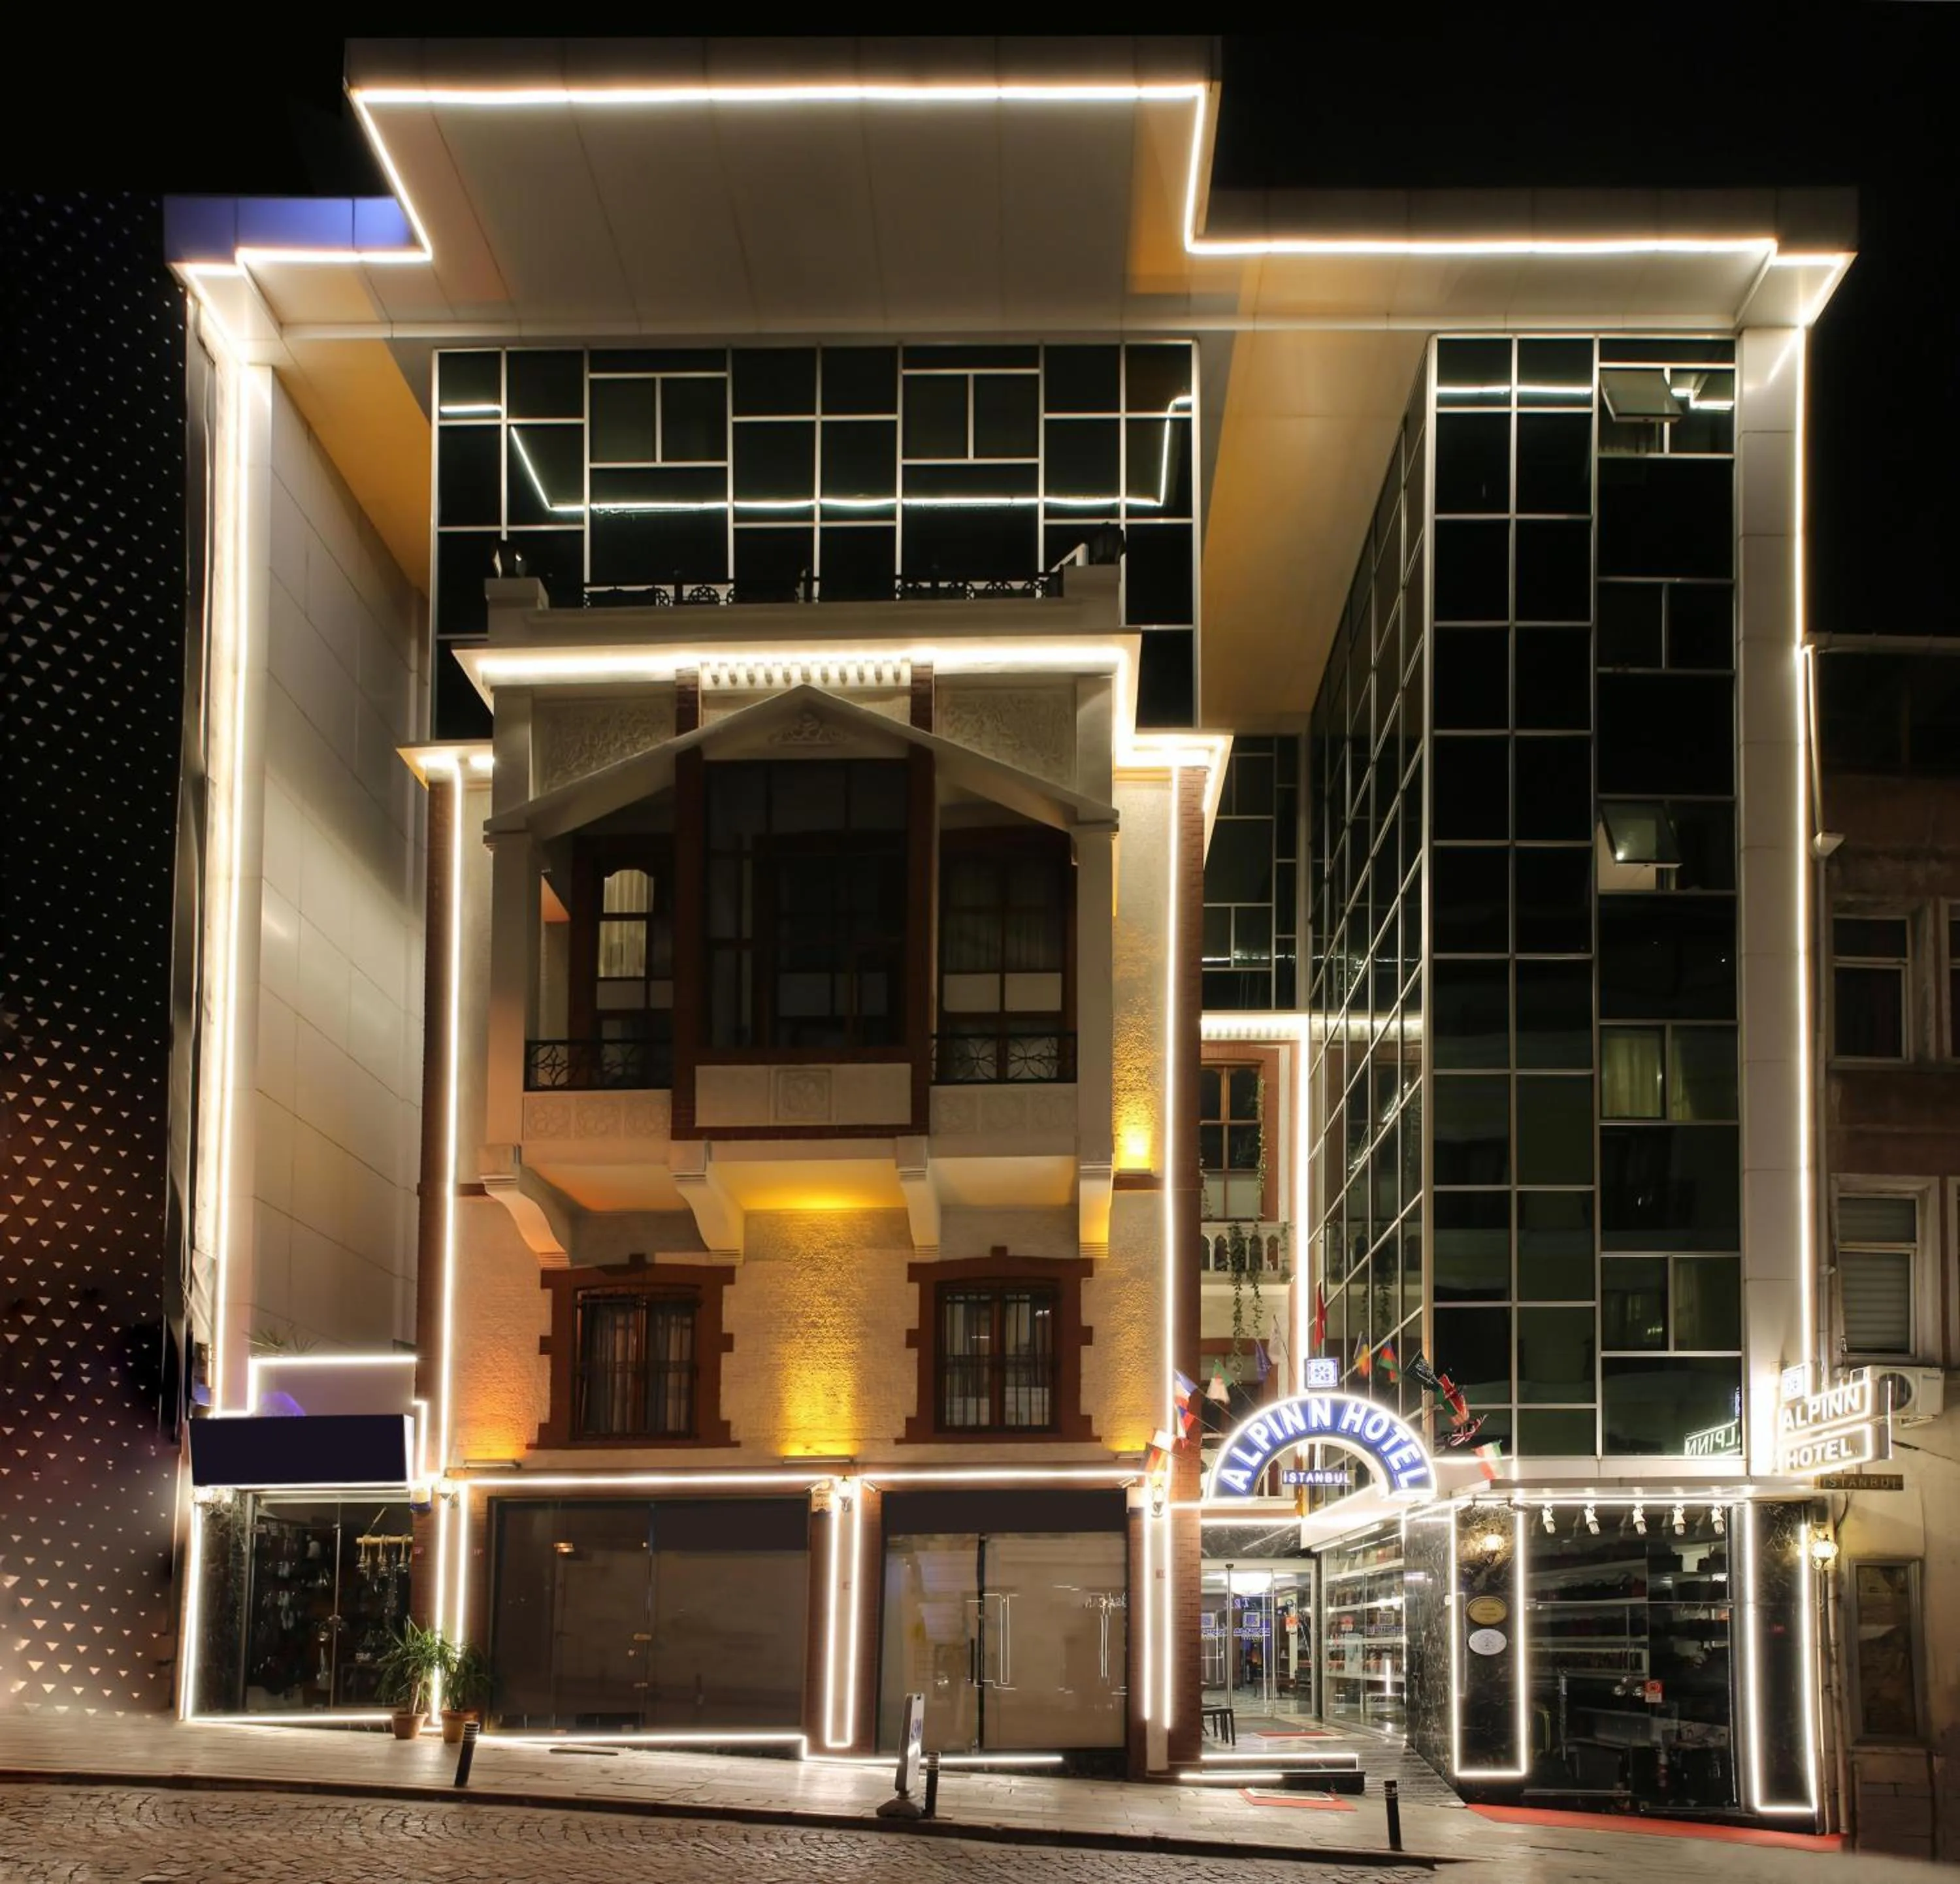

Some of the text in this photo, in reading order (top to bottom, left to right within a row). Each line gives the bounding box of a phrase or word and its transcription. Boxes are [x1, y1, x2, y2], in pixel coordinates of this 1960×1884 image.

[1783, 1385, 1861, 1431] ALPINN
[1221, 1398, 1427, 1492] ALPINN HOTEL
[1786, 1437, 1853, 1470] HOTEL
